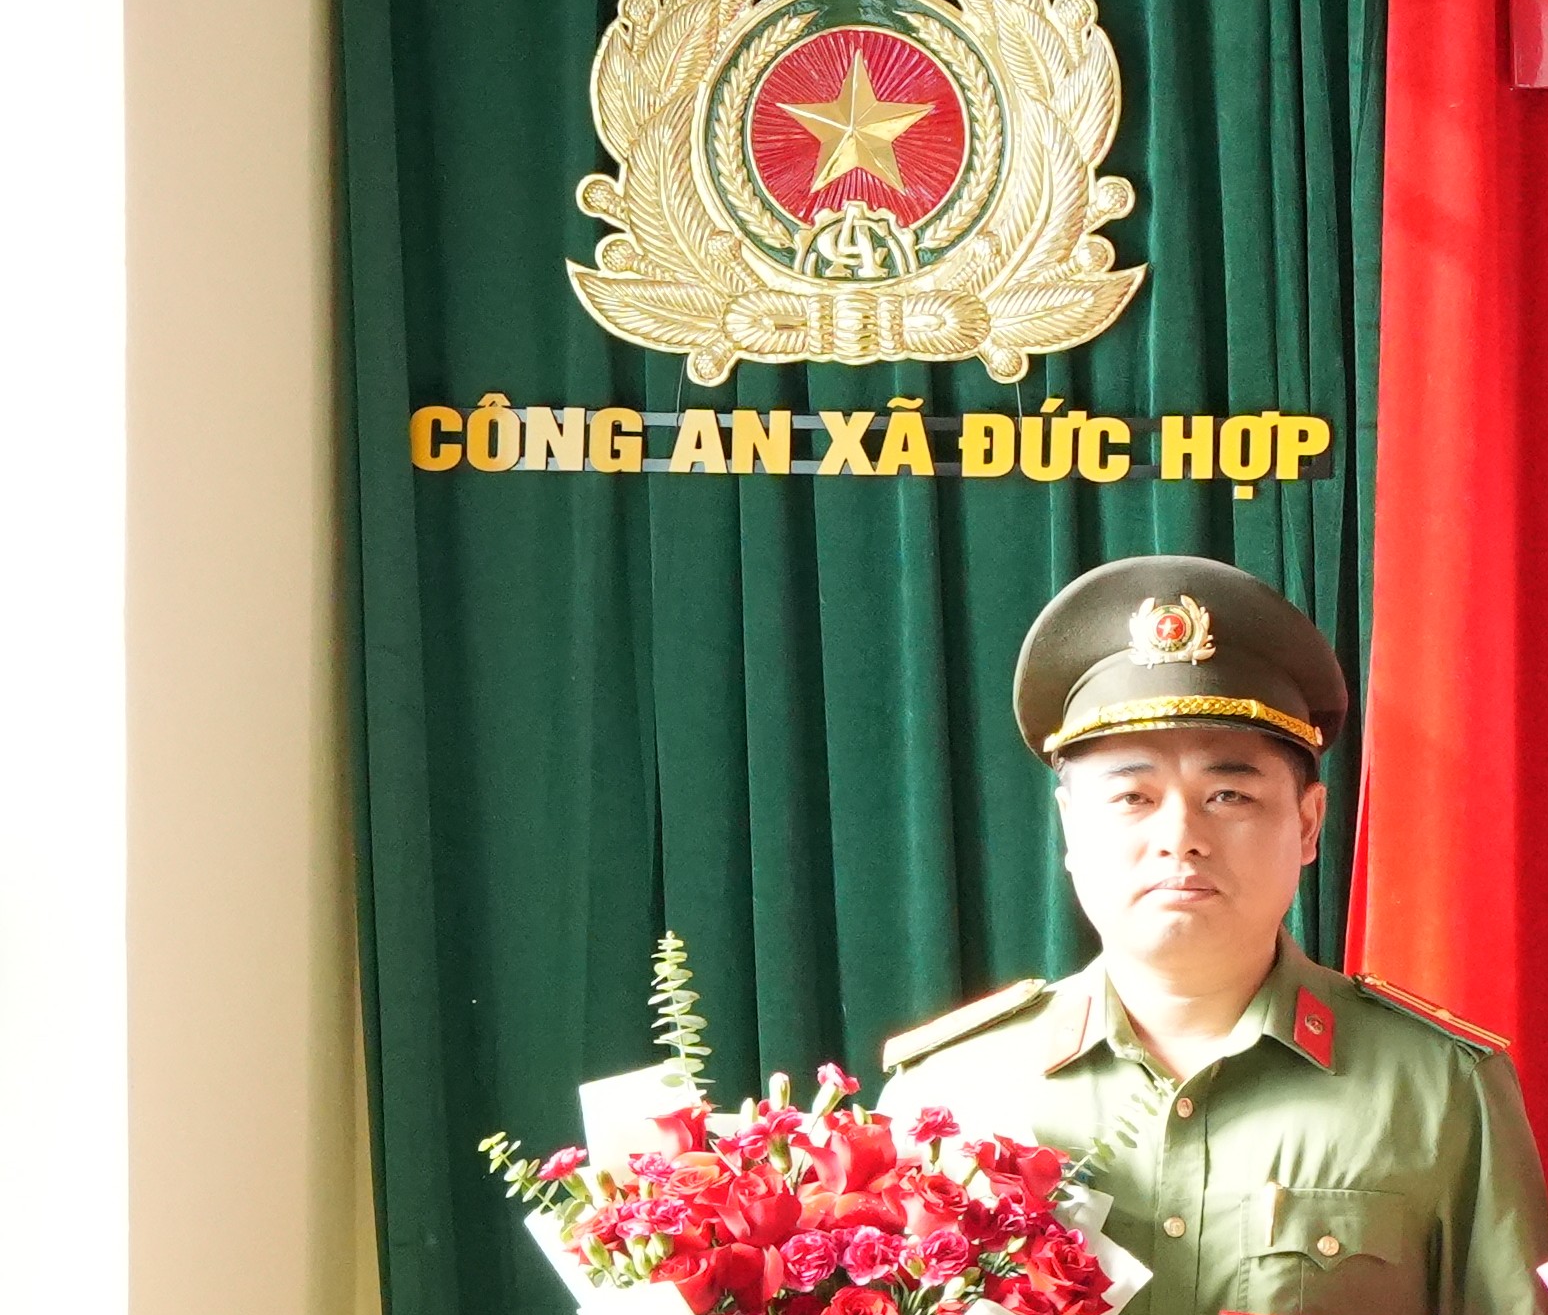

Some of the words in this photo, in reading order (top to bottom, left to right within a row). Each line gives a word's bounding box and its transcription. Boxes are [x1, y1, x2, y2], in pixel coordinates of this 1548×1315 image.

[408, 392, 644, 473] CÔNG
[667, 409, 792, 475] AN
[816, 396, 935, 477] XÃ
[958, 397, 1132, 483] ĐỨC
[1160, 410, 1332, 500] HỢP
